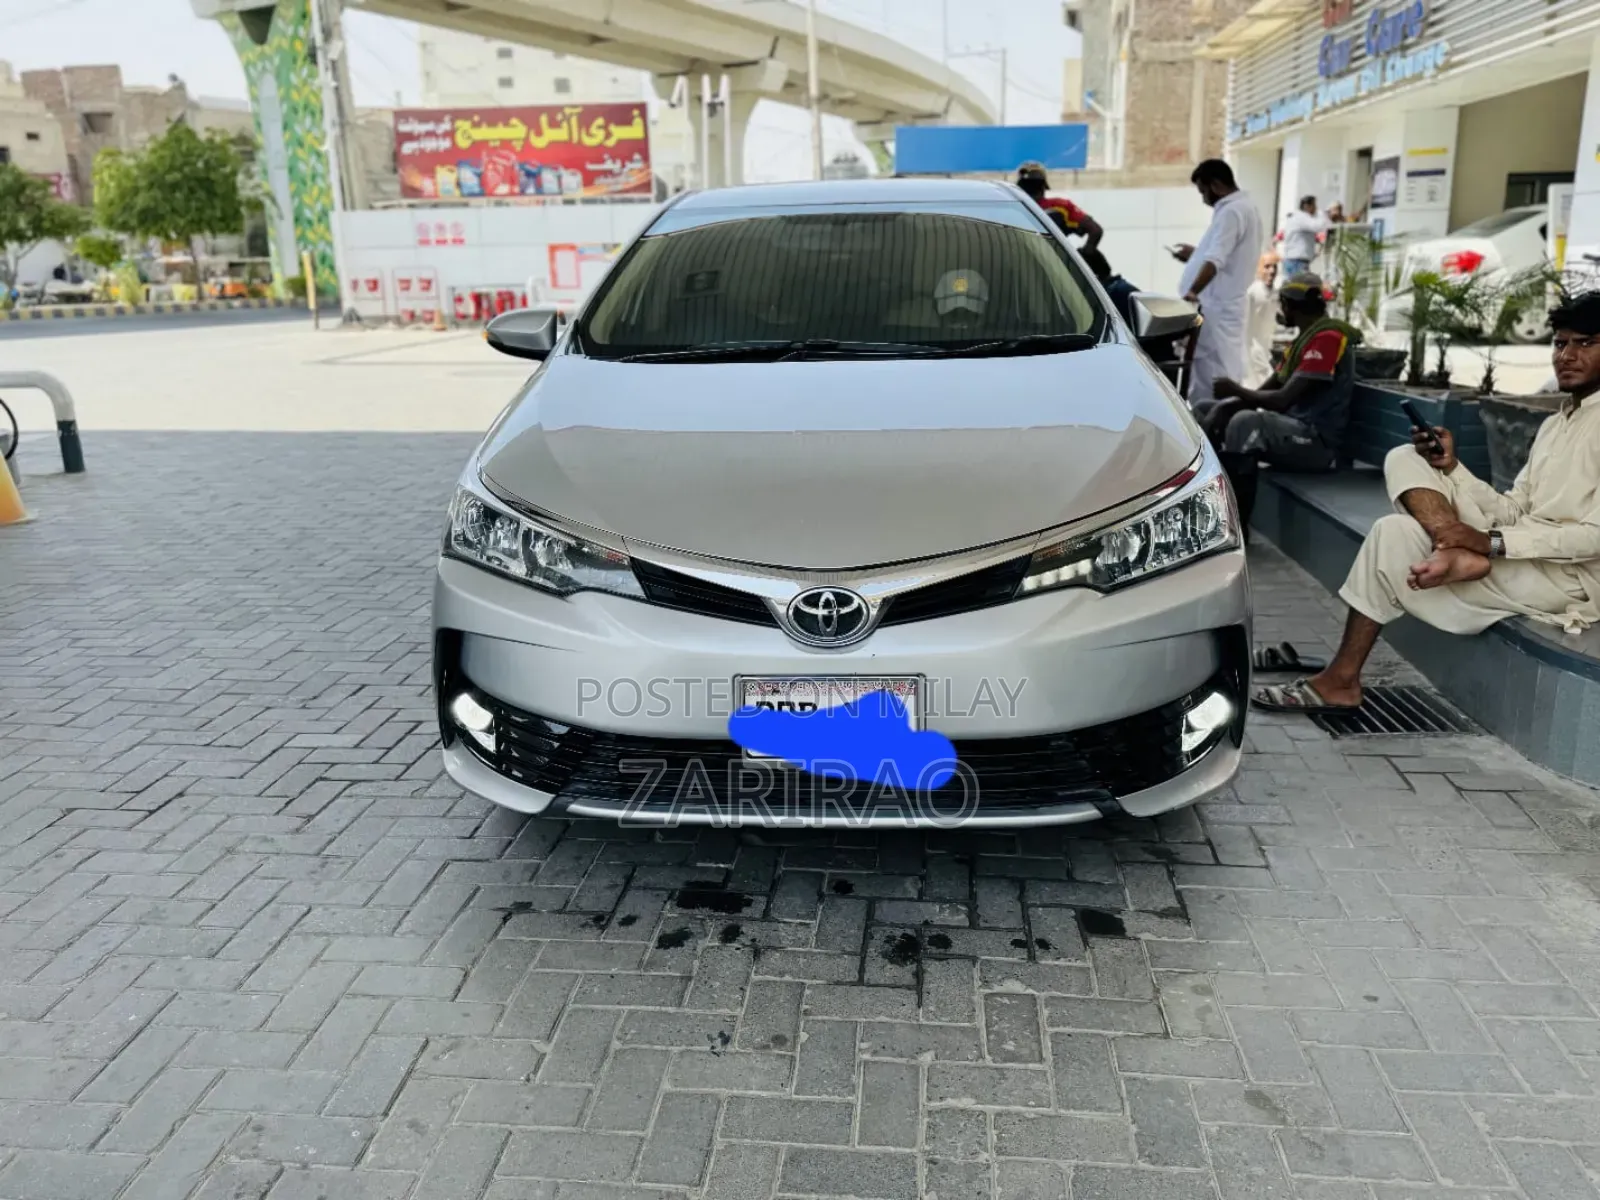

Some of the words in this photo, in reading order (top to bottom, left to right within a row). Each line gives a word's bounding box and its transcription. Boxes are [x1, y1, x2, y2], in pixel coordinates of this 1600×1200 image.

[454, 114, 528, 151] چینج
[529, 105, 583, 149] آئل
[581, 108, 645, 147] فری
